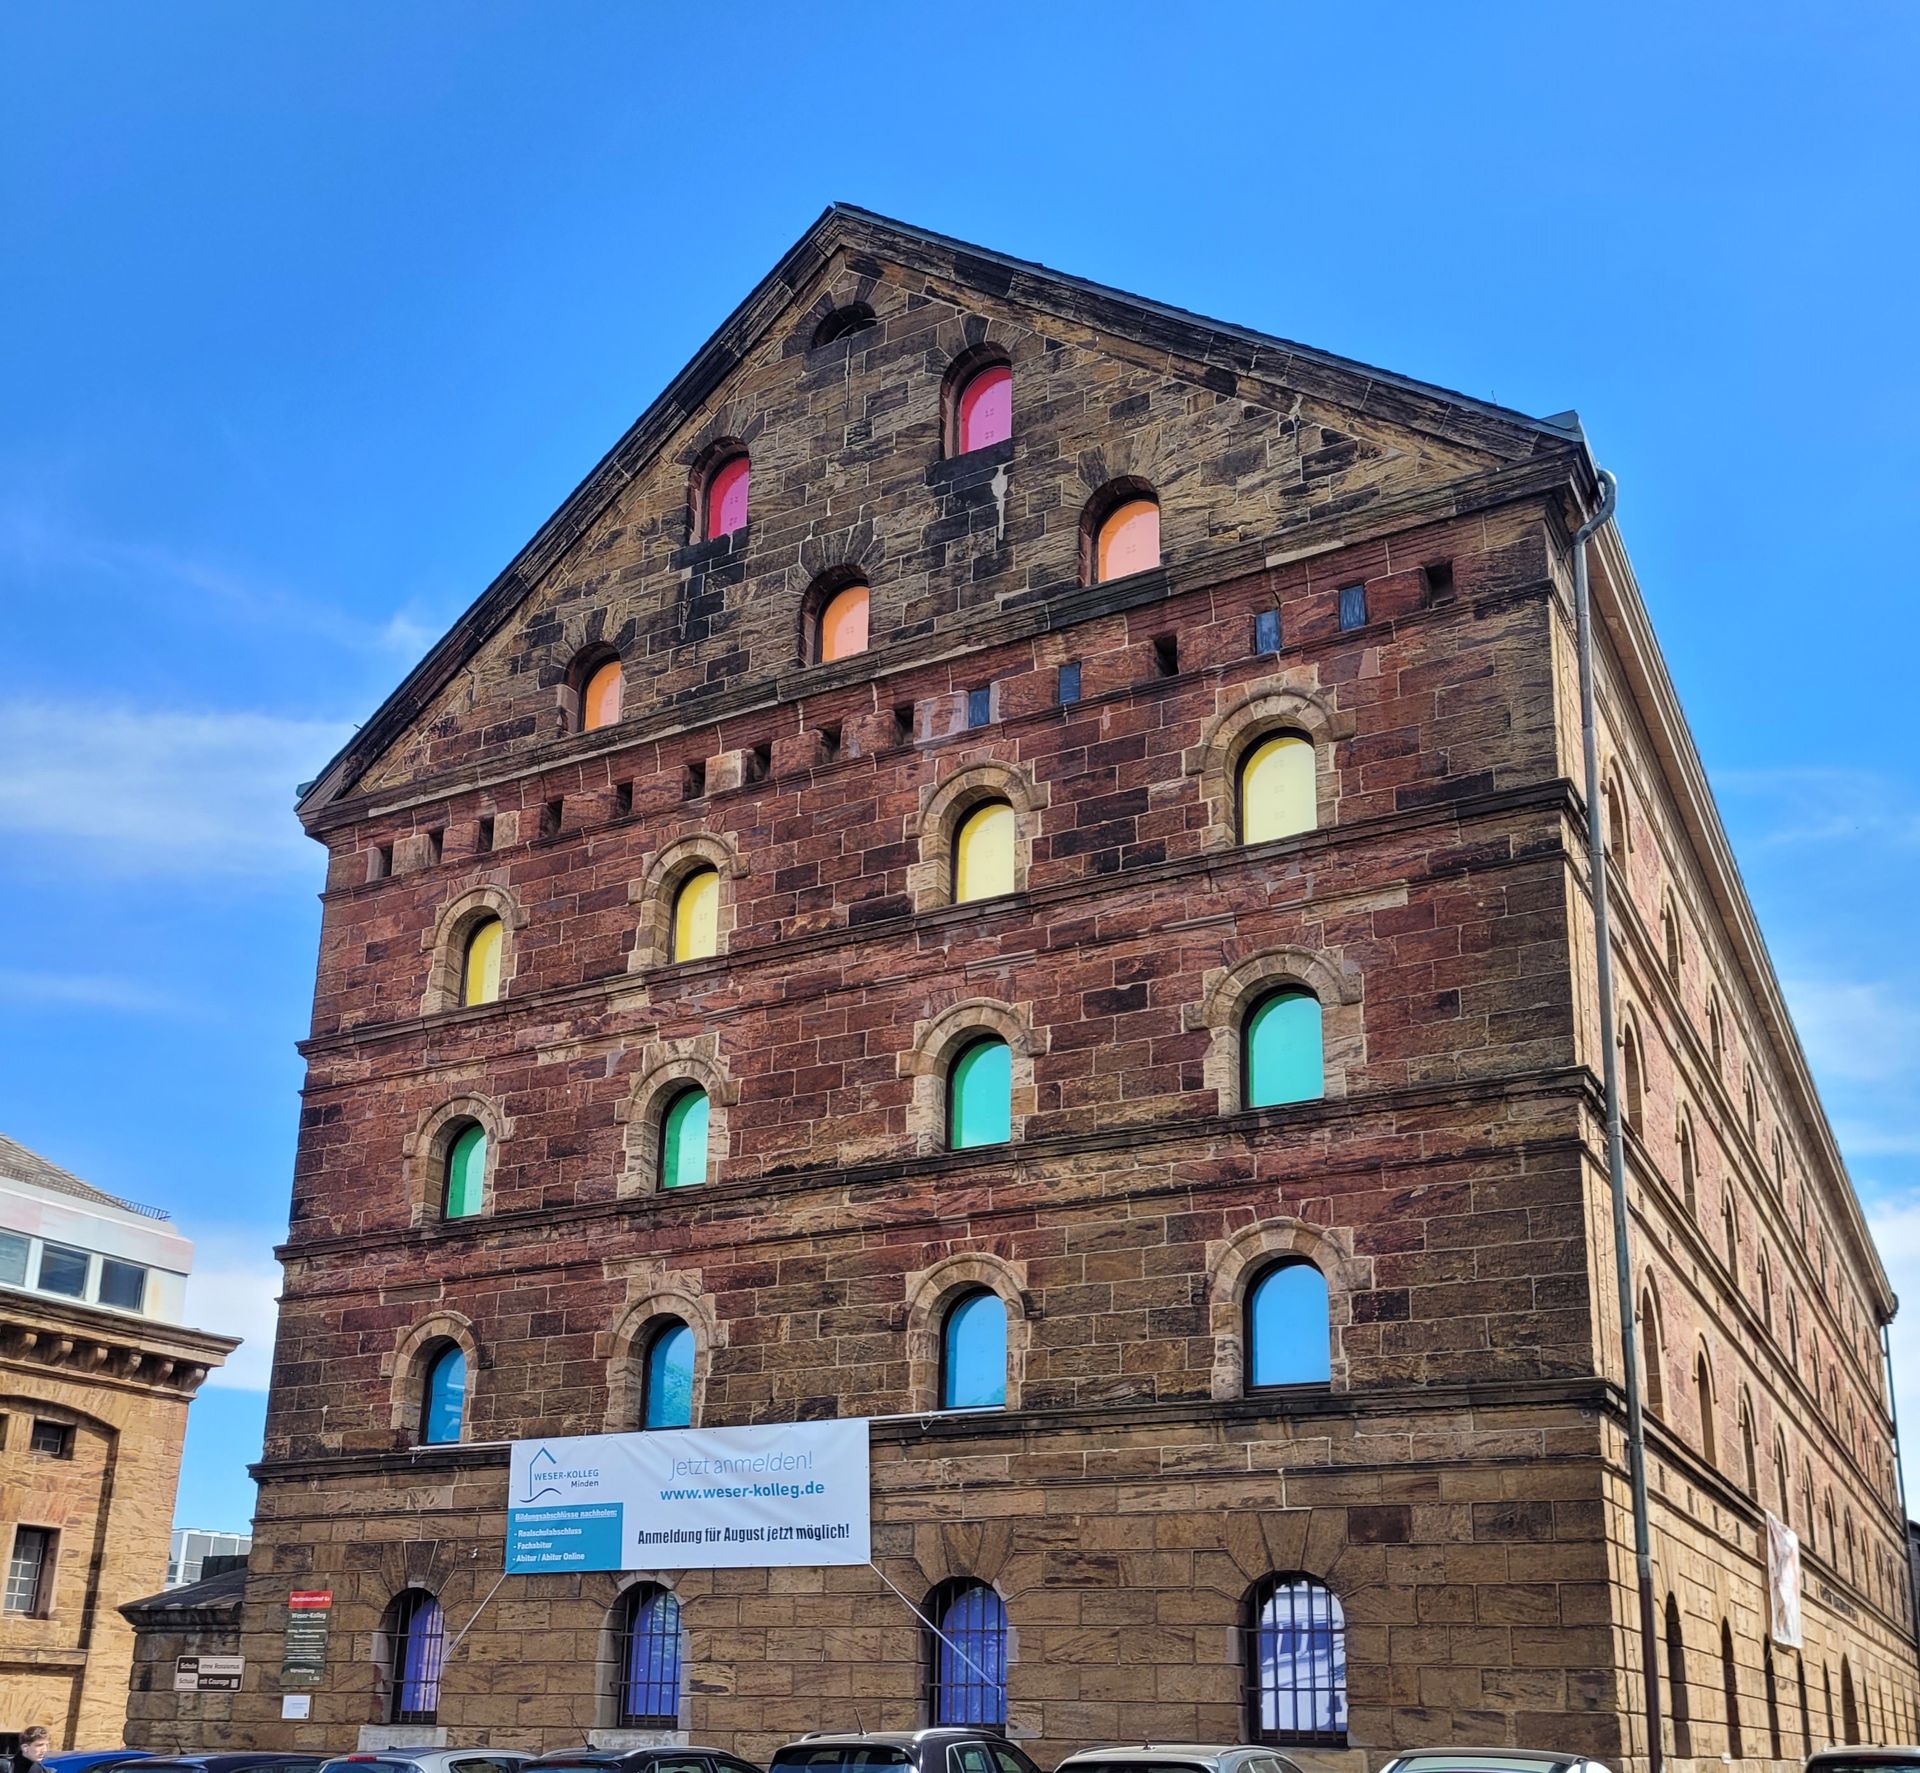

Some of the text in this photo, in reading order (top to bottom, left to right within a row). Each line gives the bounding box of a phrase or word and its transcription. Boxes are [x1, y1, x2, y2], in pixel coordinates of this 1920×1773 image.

[668, 1451, 813, 1482] Jetzt anmelden!
[534, 1469, 599, 1481] WESER-KOLLEG
[571, 1480, 599, 1488] Minden
[660, 1481, 825, 1501] www.weser-kolleg.de
[515, 1508, 618, 1522] Bildungsabschlüsse nachholen:
[518, 1528, 582, 1537] Realschulabschluss
[638, 1523, 850, 1545] Anmeldung für August jetzt möglich!
[517, 1541, 552, 1550] Fachabitur
[516, 1554, 537, 1562] Abitur
[541, 1553, 562, 1561] Abitur
[563, 1552, 585, 1560] Online
